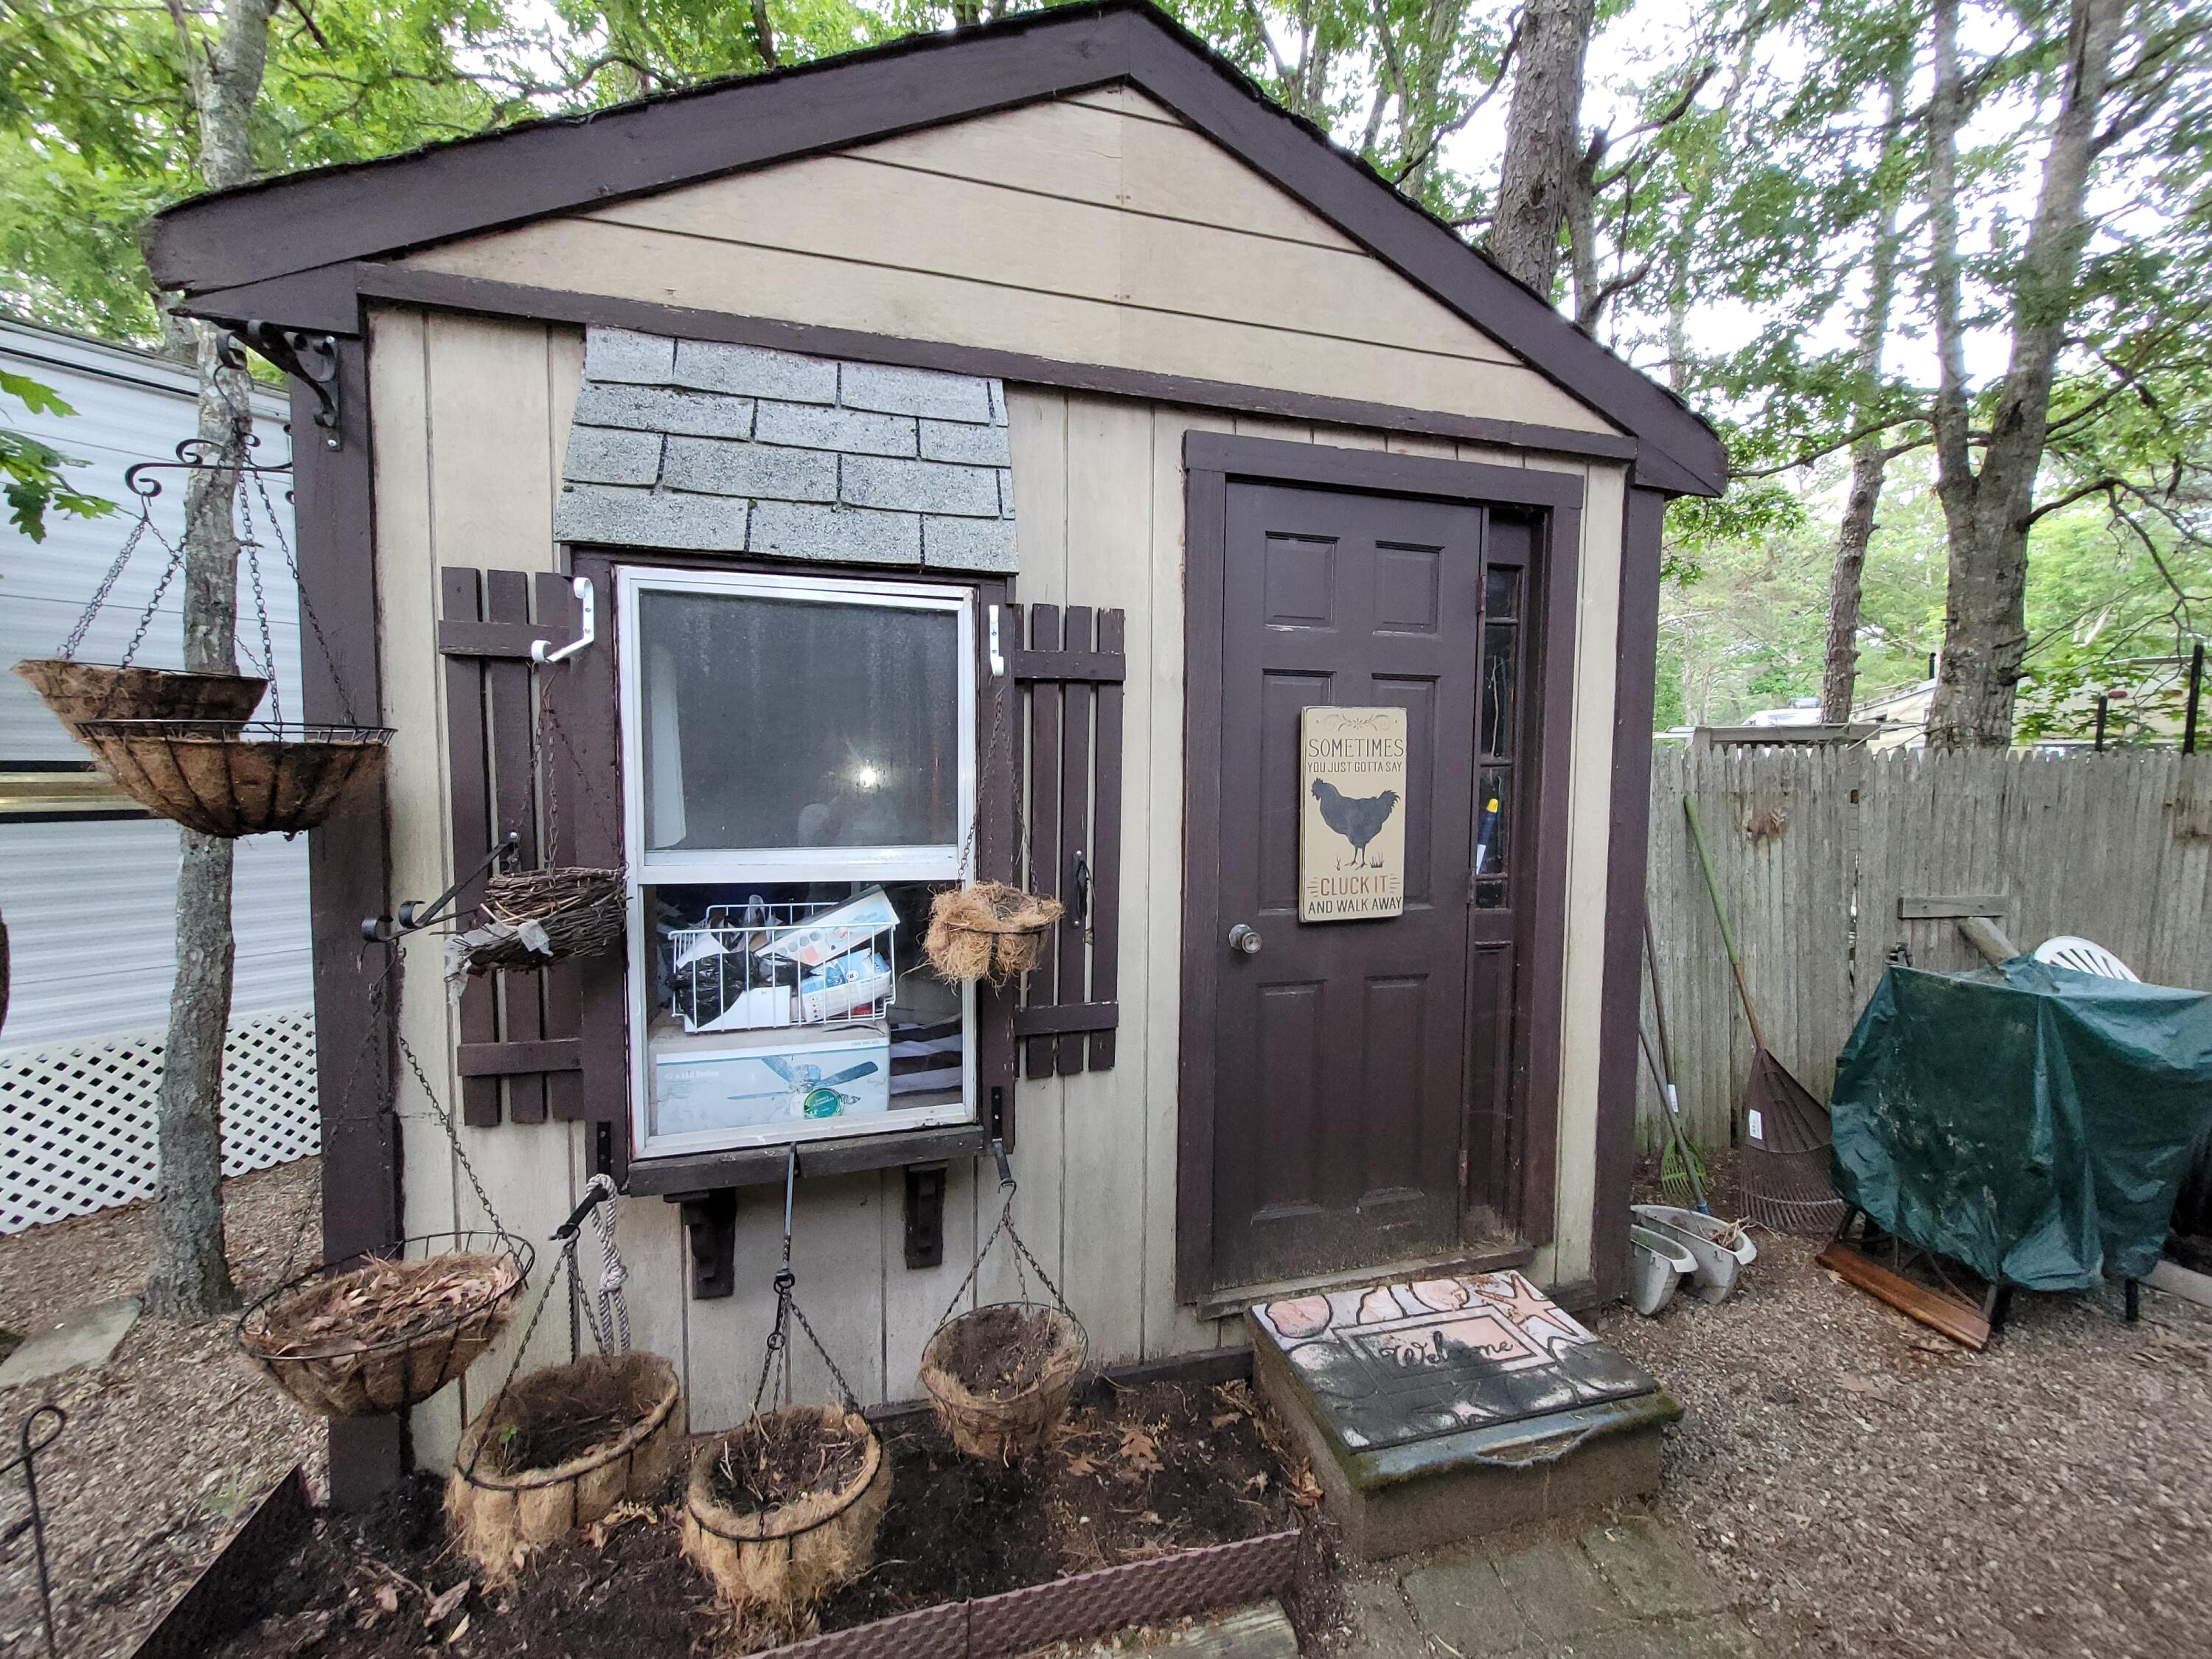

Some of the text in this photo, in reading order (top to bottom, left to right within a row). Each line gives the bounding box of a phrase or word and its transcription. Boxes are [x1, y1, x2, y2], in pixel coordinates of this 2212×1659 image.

[1308, 738, 1404, 757] SOMETIMES
[1307, 761, 1402, 773] YOU JUST GOTTA SAY
[1321, 875, 1388, 896] CLUCK IT
[1308, 896, 1402, 914] AND WALK AWAY
[1379, 1330, 1513, 1368] Welme
